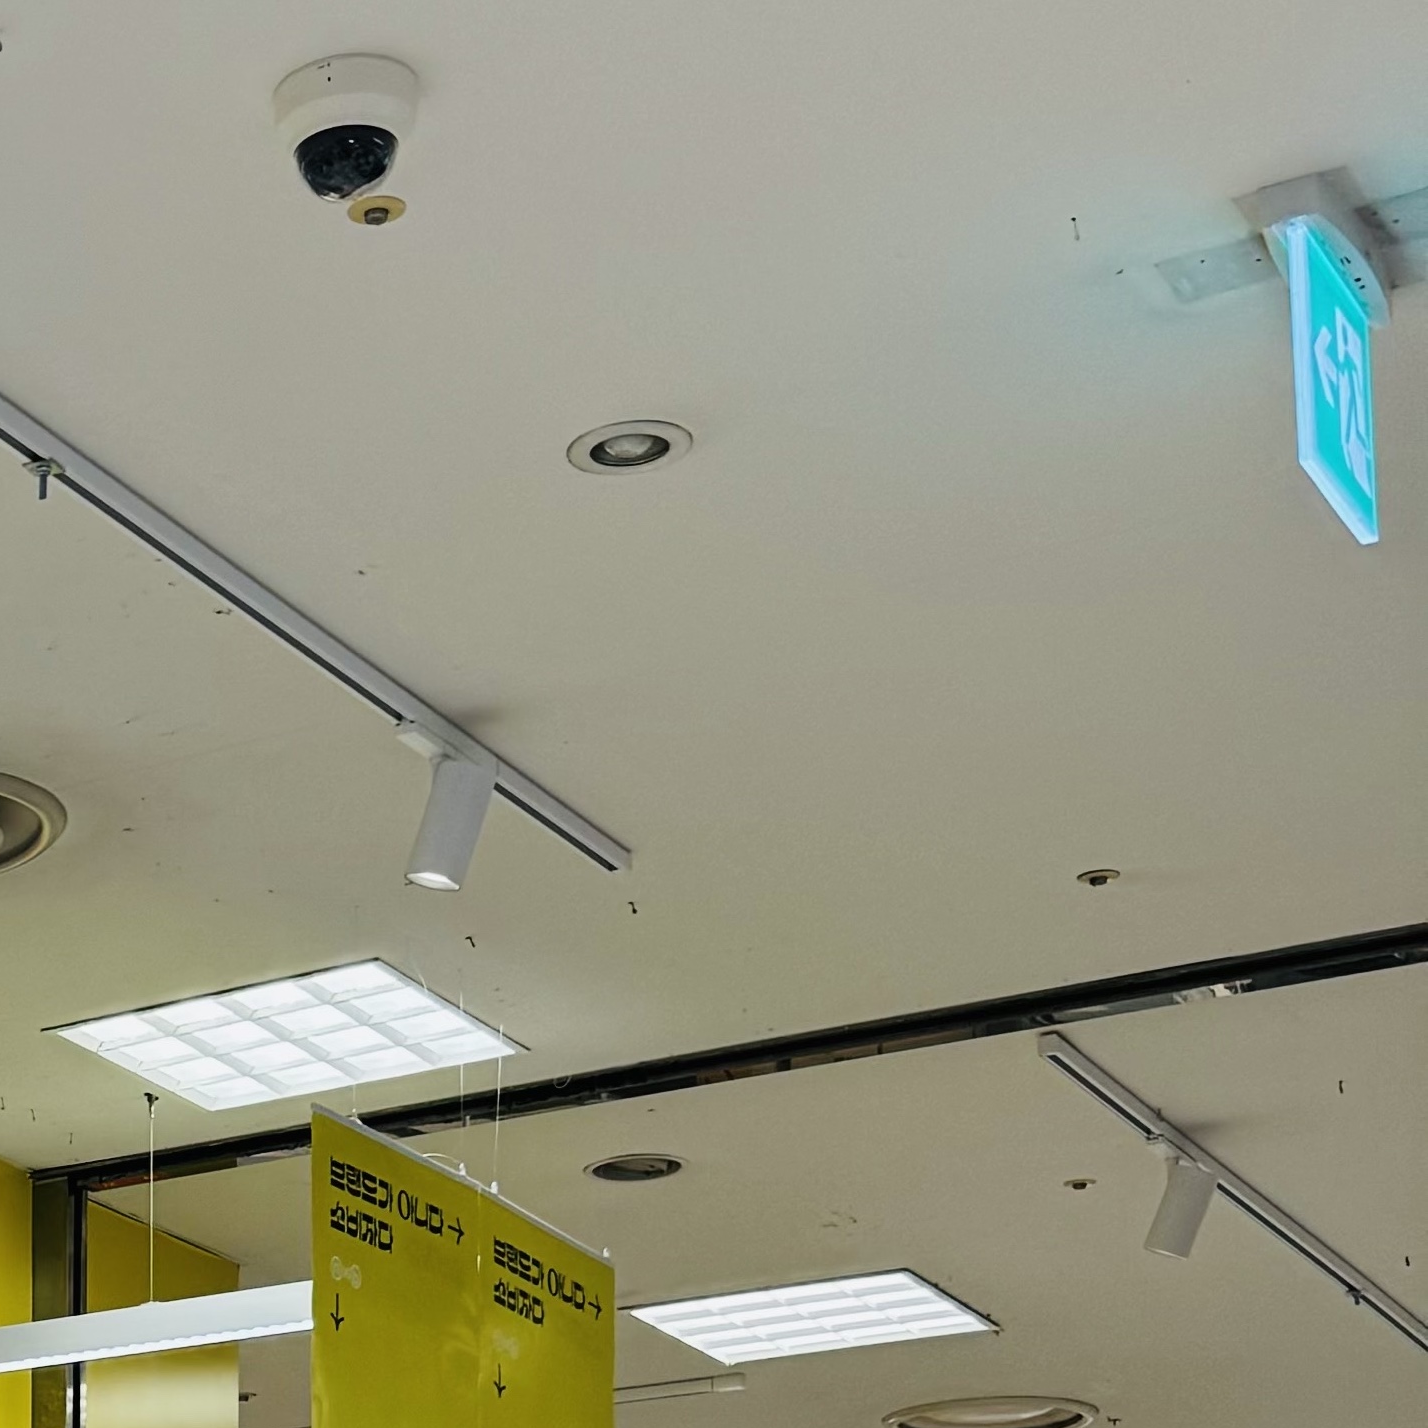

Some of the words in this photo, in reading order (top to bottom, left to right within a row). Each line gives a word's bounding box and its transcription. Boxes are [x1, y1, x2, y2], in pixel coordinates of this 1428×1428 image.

[330, 1156, 392, 1212] 브랜드가
[398, 1190, 443, 1236] 아니다
[330, 1201, 392, 1253] 소비자다
[494, 1237, 543, 1289] 브랜드가
[548, 1268, 584, 1312] 아니다
[494, 1278, 543, 1326] 소비자다
